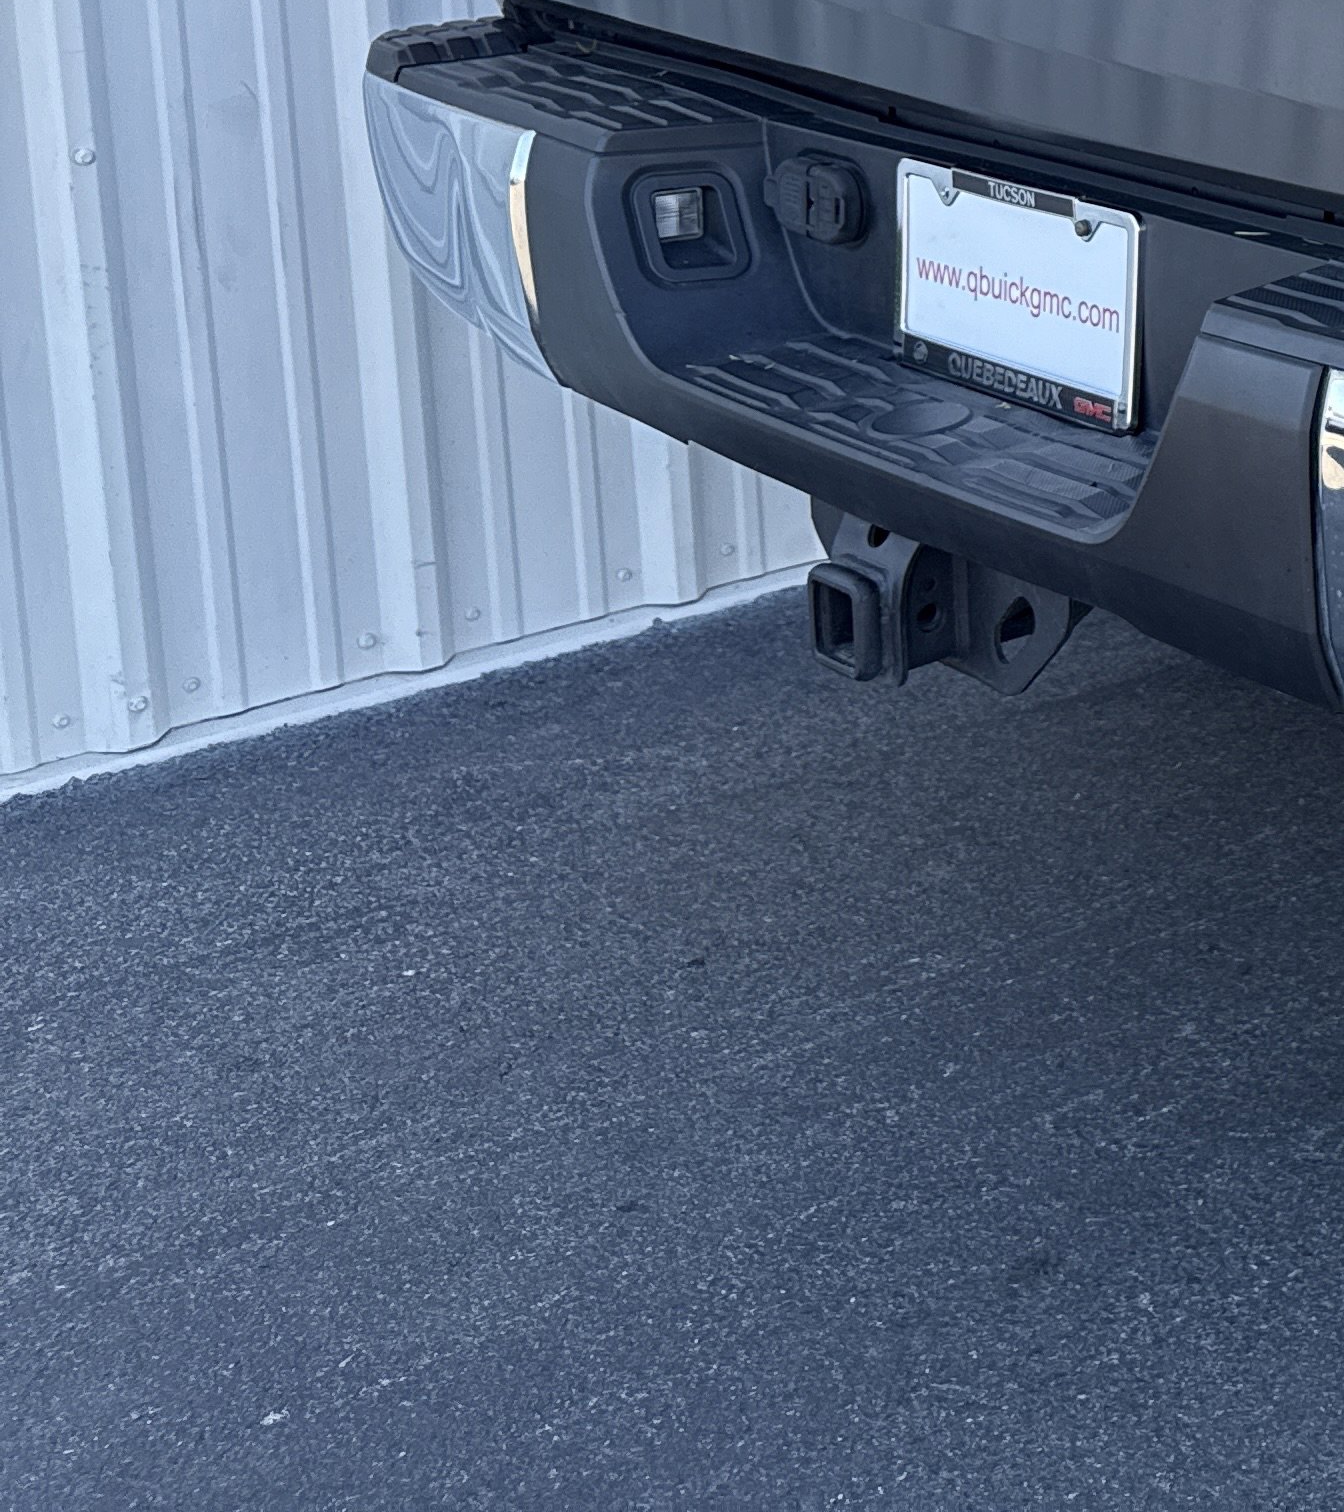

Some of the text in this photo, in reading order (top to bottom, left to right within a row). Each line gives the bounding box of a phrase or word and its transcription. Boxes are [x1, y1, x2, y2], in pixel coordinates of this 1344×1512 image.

[988, 181, 1036, 208] TUCSON
[916, 256, 1120, 334] www.qbuickgmc.com
[947, 351, 1112, 424] QUEBEDEAUX GMC
